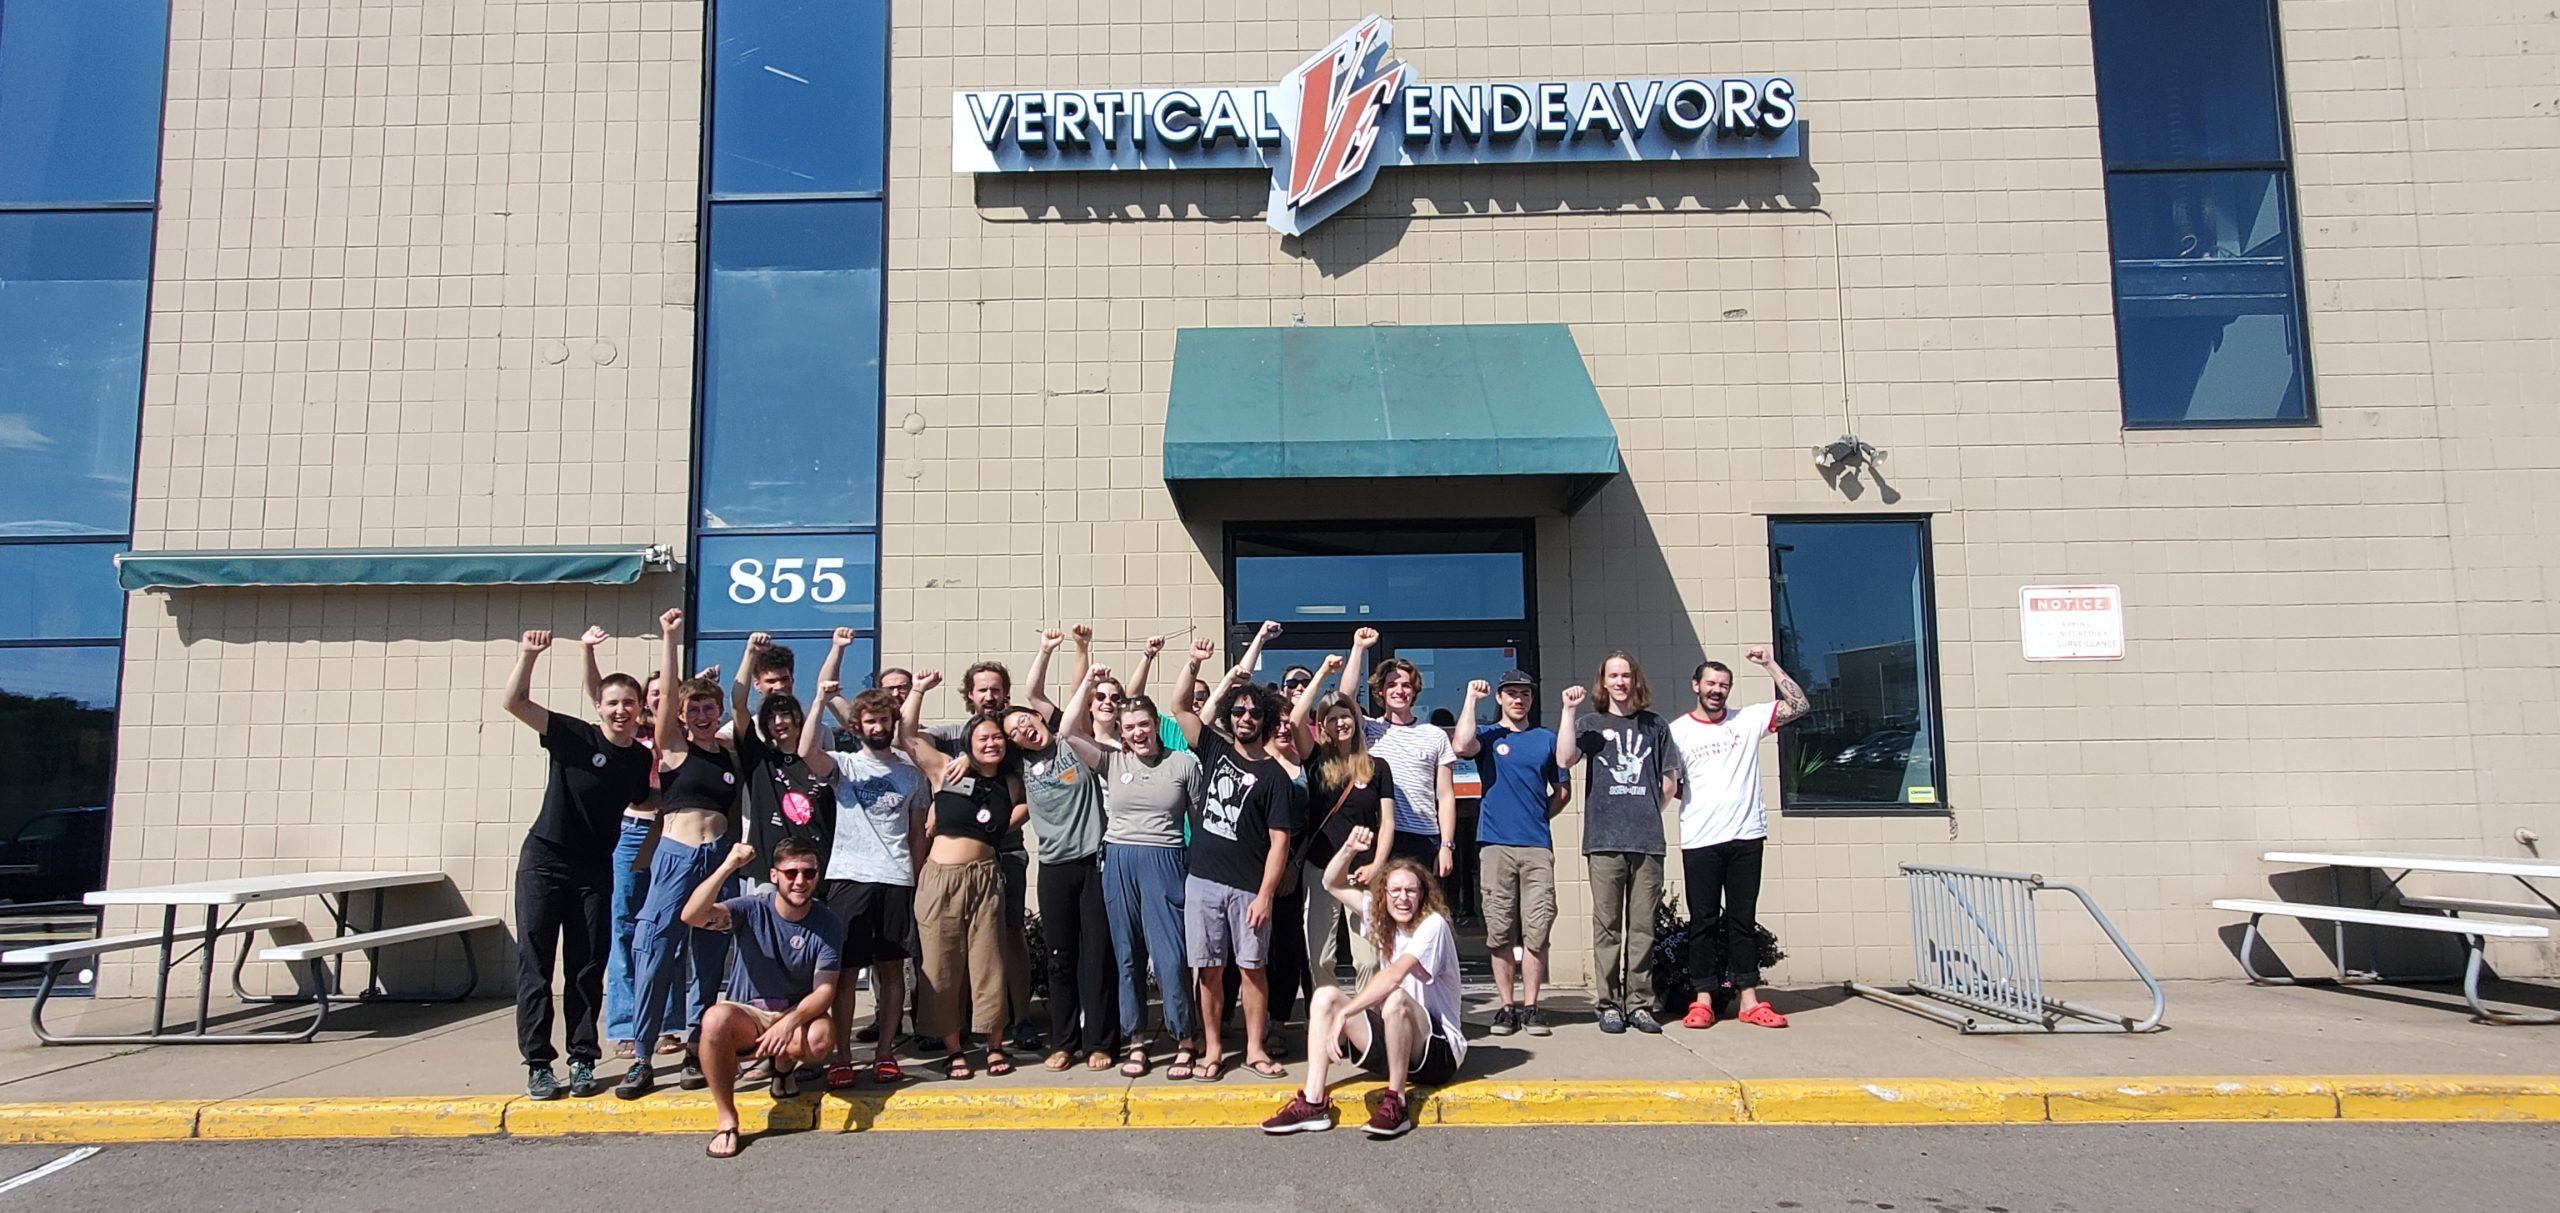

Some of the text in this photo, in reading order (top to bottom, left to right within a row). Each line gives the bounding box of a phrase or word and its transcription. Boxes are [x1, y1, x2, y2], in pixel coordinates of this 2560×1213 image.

[965, 78, 1795, 147] VERTICAL ENDEAVORS
[1287, 16, 1408, 208] VE
[728, 557, 847, 604] 855
[2037, 599, 2105, 610] NOTICE
[2057, 640, 2118, 648] SURVEILLANCE
